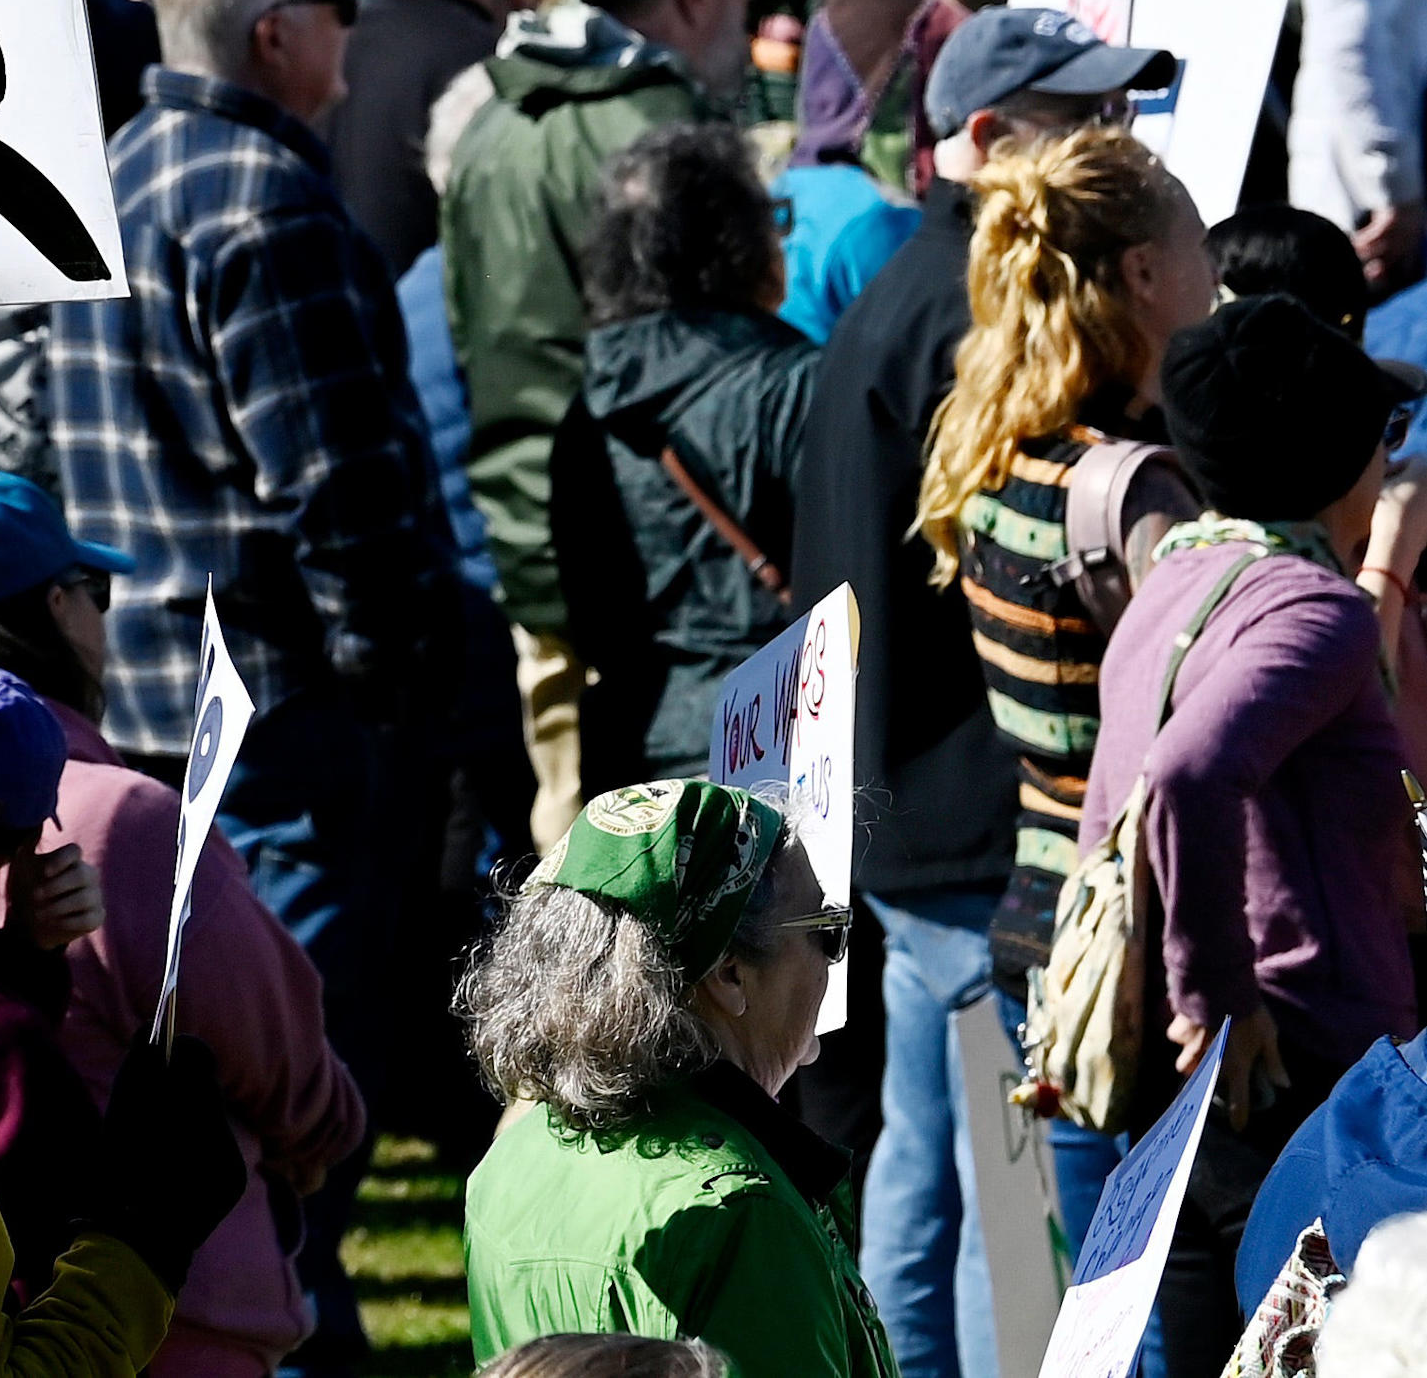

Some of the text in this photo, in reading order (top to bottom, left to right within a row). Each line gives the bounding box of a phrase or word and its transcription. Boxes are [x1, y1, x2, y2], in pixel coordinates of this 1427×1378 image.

[722, 618, 826, 785] YOUR WARS
[810, 754, 832, 820] US
